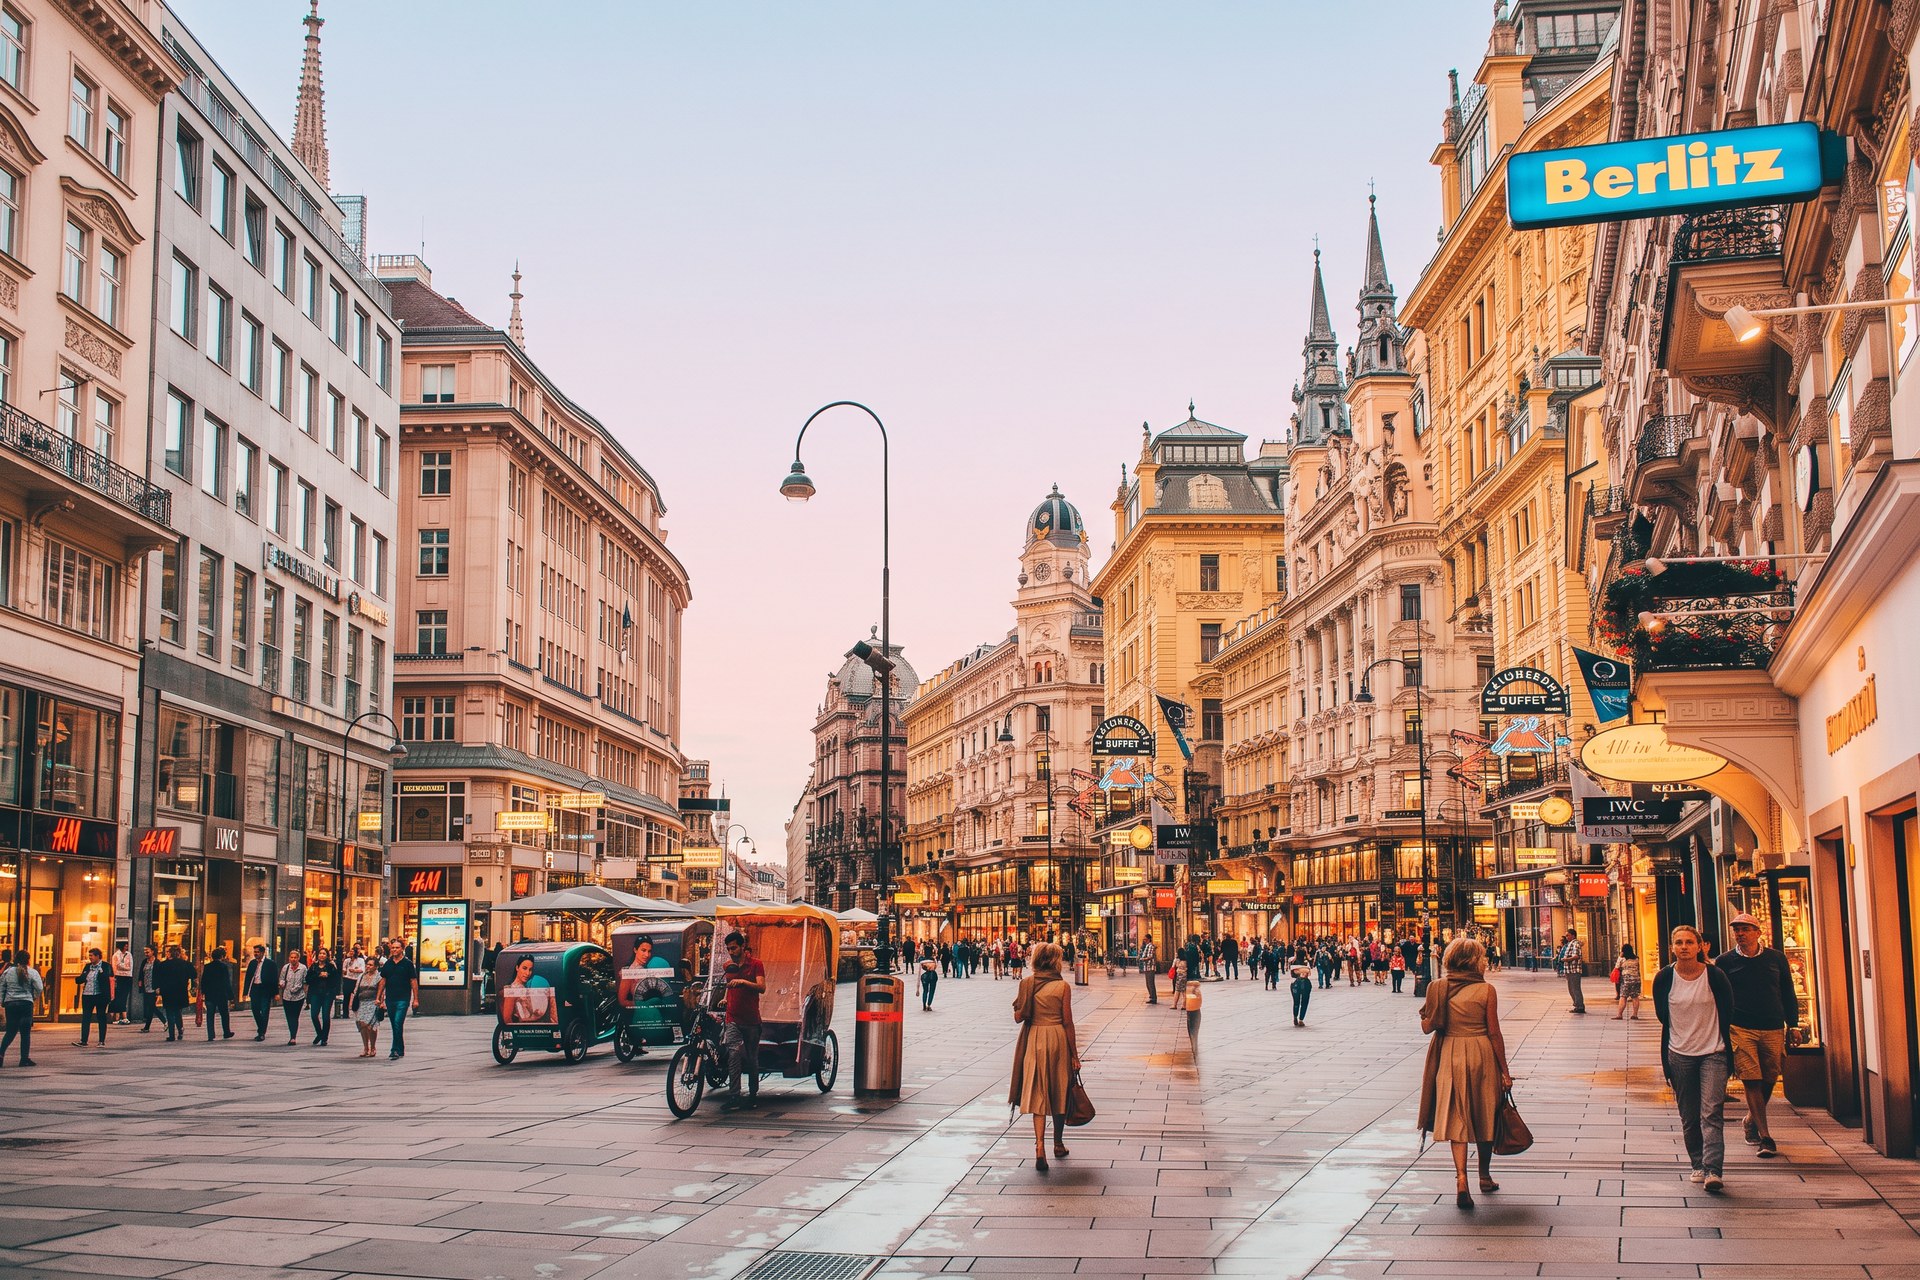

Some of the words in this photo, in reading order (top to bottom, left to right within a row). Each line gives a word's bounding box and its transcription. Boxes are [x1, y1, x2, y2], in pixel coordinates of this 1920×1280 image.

[1545, 141, 1784, 204] Berlitz
[1499, 695, 1547, 705] BUFFET
[1609, 800, 1646, 813] IWC
[52, 817, 82, 854] H&M
[139, 829, 175, 854] H&M
[215, 826, 239, 851] IWC
